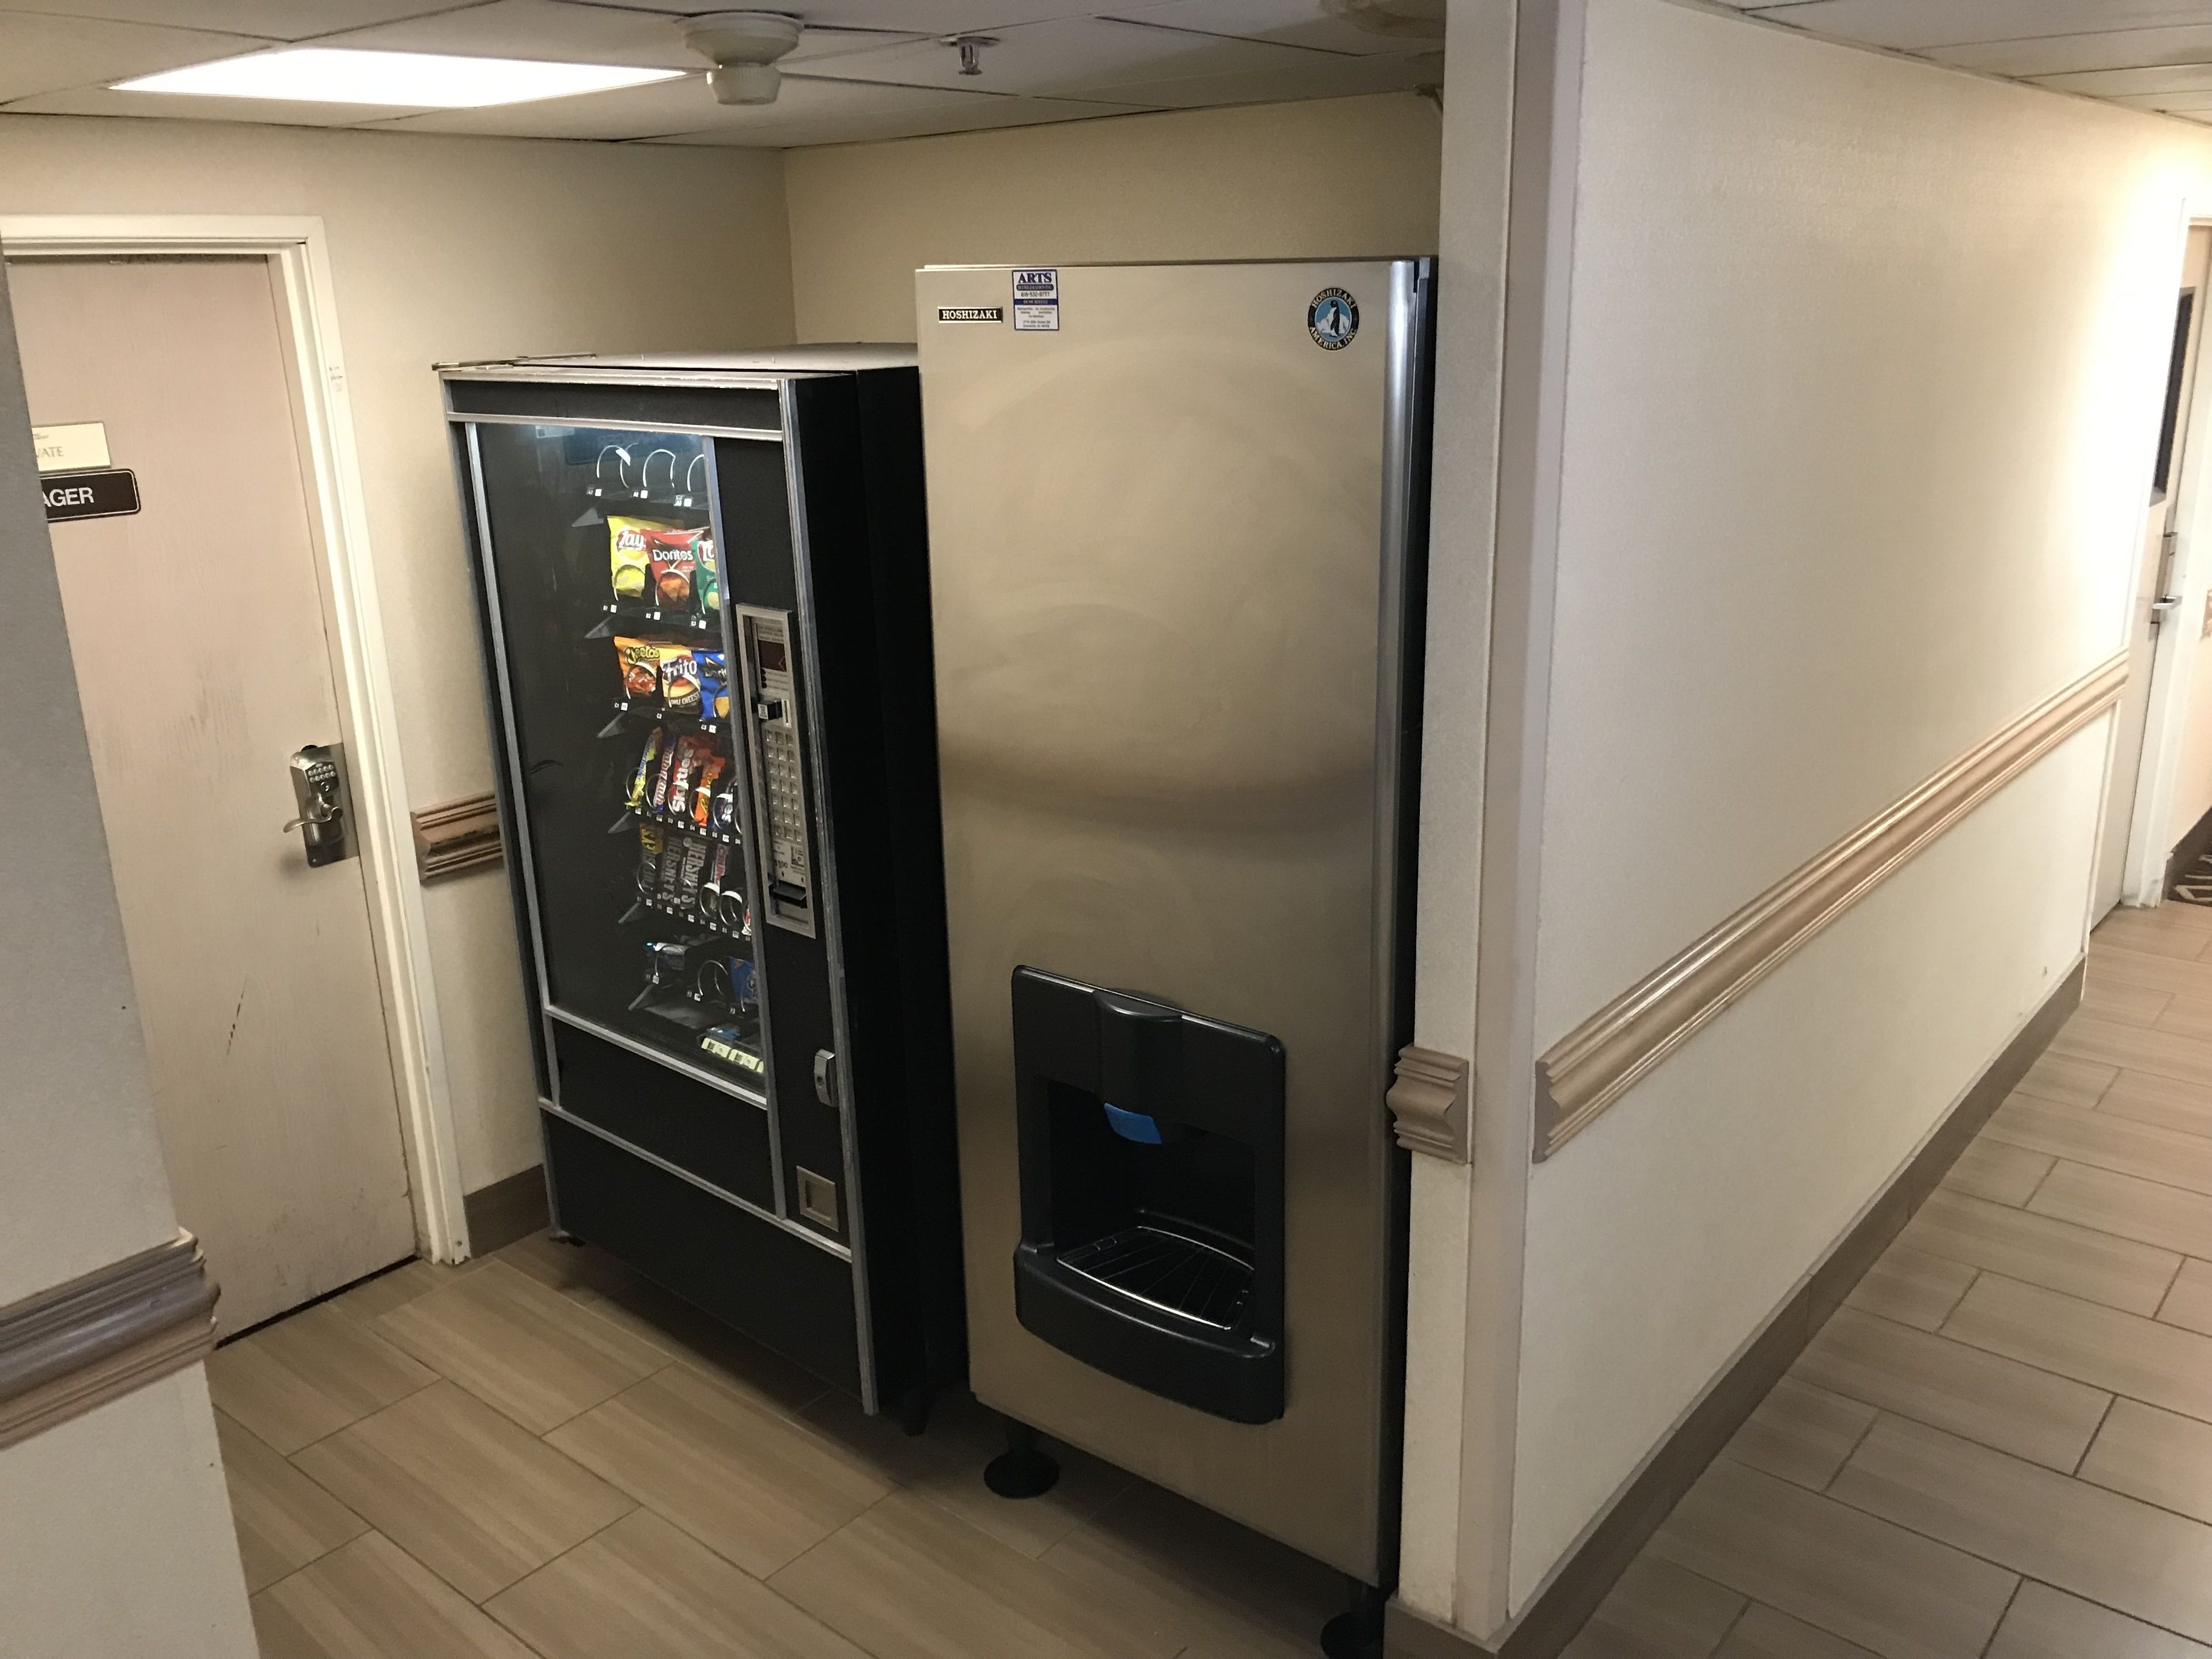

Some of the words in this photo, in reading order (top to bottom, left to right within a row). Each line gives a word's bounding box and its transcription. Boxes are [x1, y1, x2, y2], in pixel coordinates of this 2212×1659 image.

[1018, 272, 1052, 283] ARTS
[1311, 289, 1357, 308] HOSHIZAKI
[942, 310, 997, 319] HOSHIZAKI
[42, 487, 94, 507] AGER
[652, 549, 694, 561] Doritos
[624, 646, 660, 664] Cheetos
